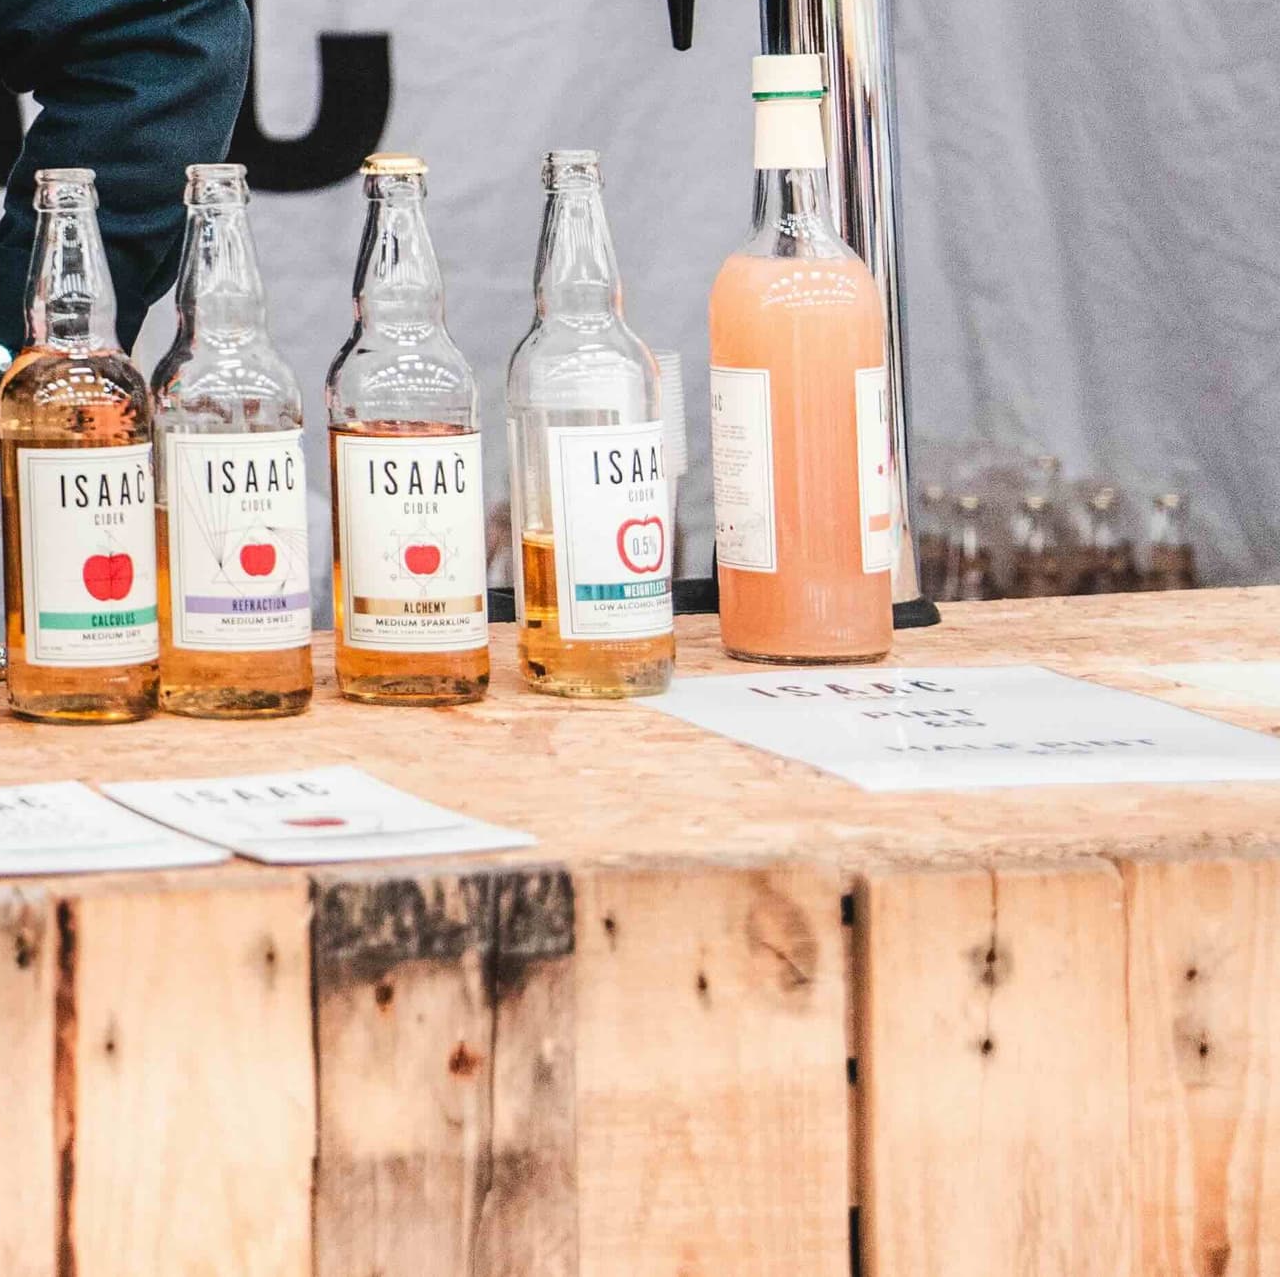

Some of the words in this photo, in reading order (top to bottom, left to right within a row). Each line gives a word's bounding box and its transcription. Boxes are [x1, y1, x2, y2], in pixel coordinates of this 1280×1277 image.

[241, 499, 273, 512] CIDER
[403, 501, 439, 515] CIDER
[232, 597, 287, 612] REFRACTION
[403, 601, 447, 614] ALCHEMY
[594, 603, 616, 611] LOW
[617, 601, 655, 610] ALCOHOL
[92, 612, 136, 628] CALCULUS
[221, 616, 264, 625] MEDIUM
[375, 618, 417, 627] MEDIUM
[420, 616, 471, 627] SPARKLING
[83, 631, 124, 641] MEDIUM
[861, 708, 977, 720] PINT
